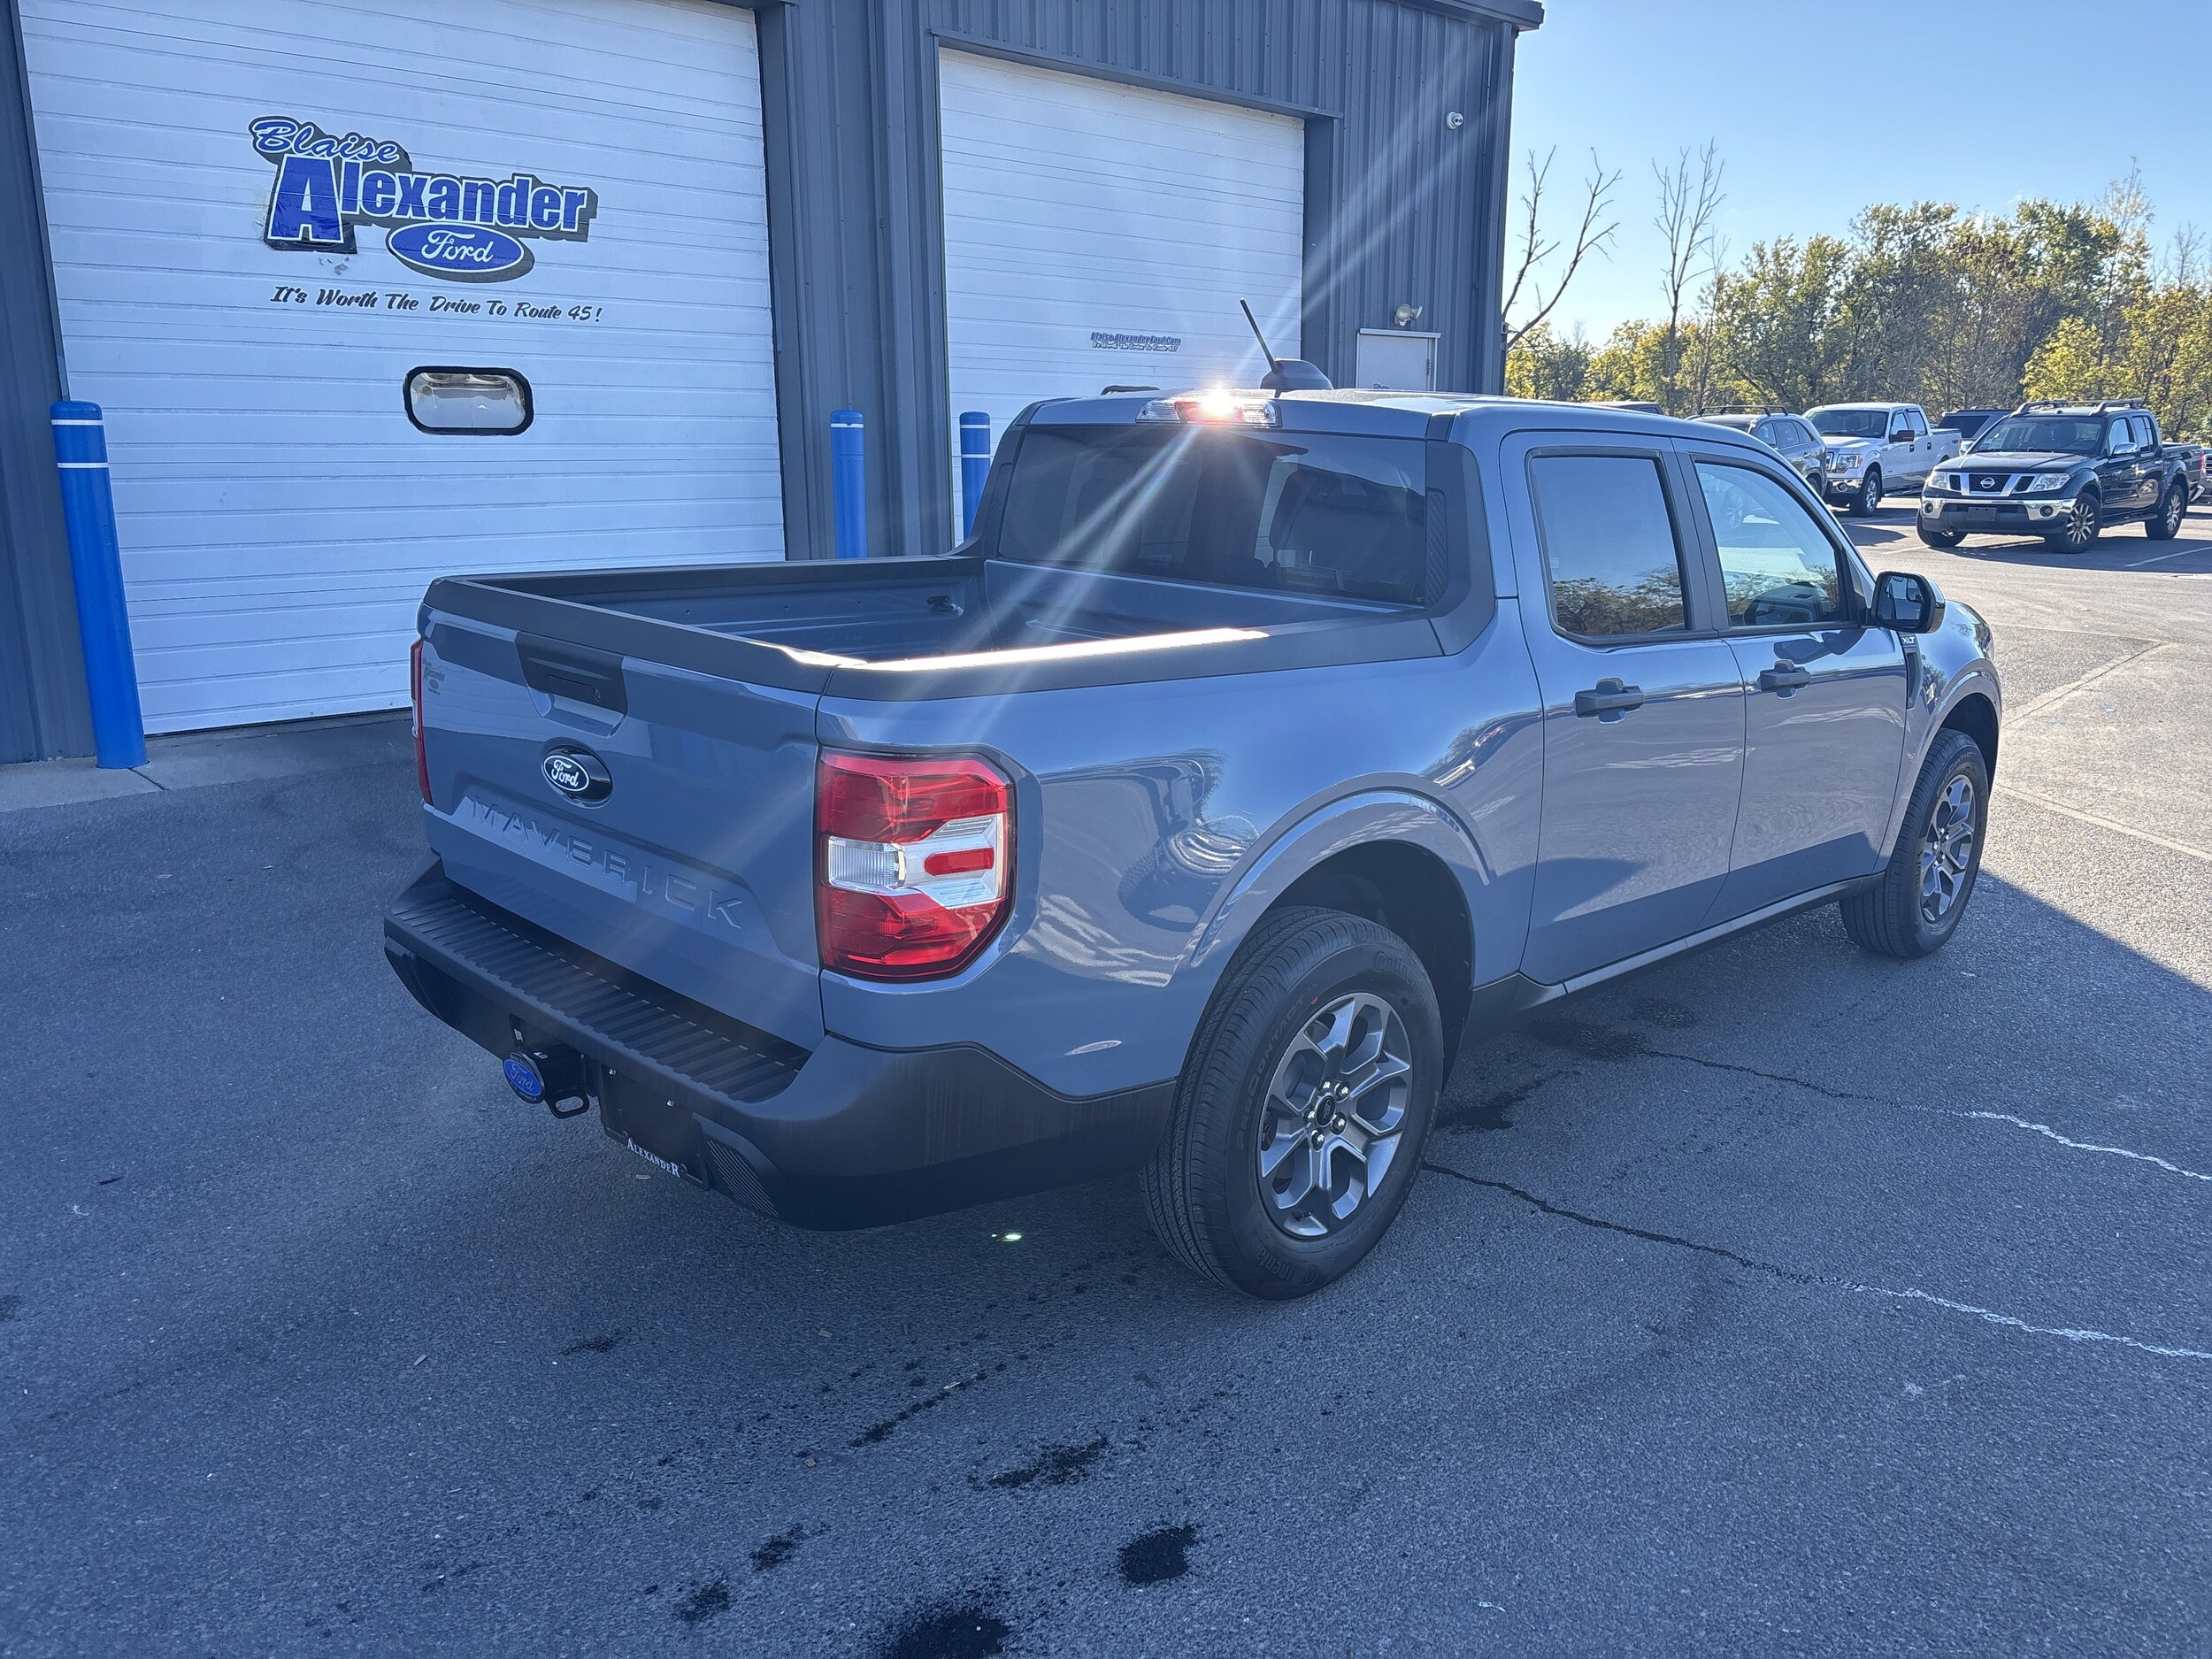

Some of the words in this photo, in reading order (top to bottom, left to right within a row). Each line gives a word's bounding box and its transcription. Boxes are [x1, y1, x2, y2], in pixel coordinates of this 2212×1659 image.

[253, 119, 400, 164] Blaise
[267, 154, 588, 242] Alexander
[421, 232, 494, 265] Ford
[269, 286, 308, 303] It's
[316, 288, 379, 307] Worth
[385, 293, 419, 311] The
[429, 296, 481, 315] Drive
[486, 300, 508, 316] To
[513, 302, 563, 319] Route
[551, 759, 580, 787] Ford
[471, 796, 743, 930] MAVERICK
[510, 1063, 534, 1092] Ford
[1236, 994, 1304, 1150] PROCONTACT
[627, 1137, 680, 1179] ALEXANDER
